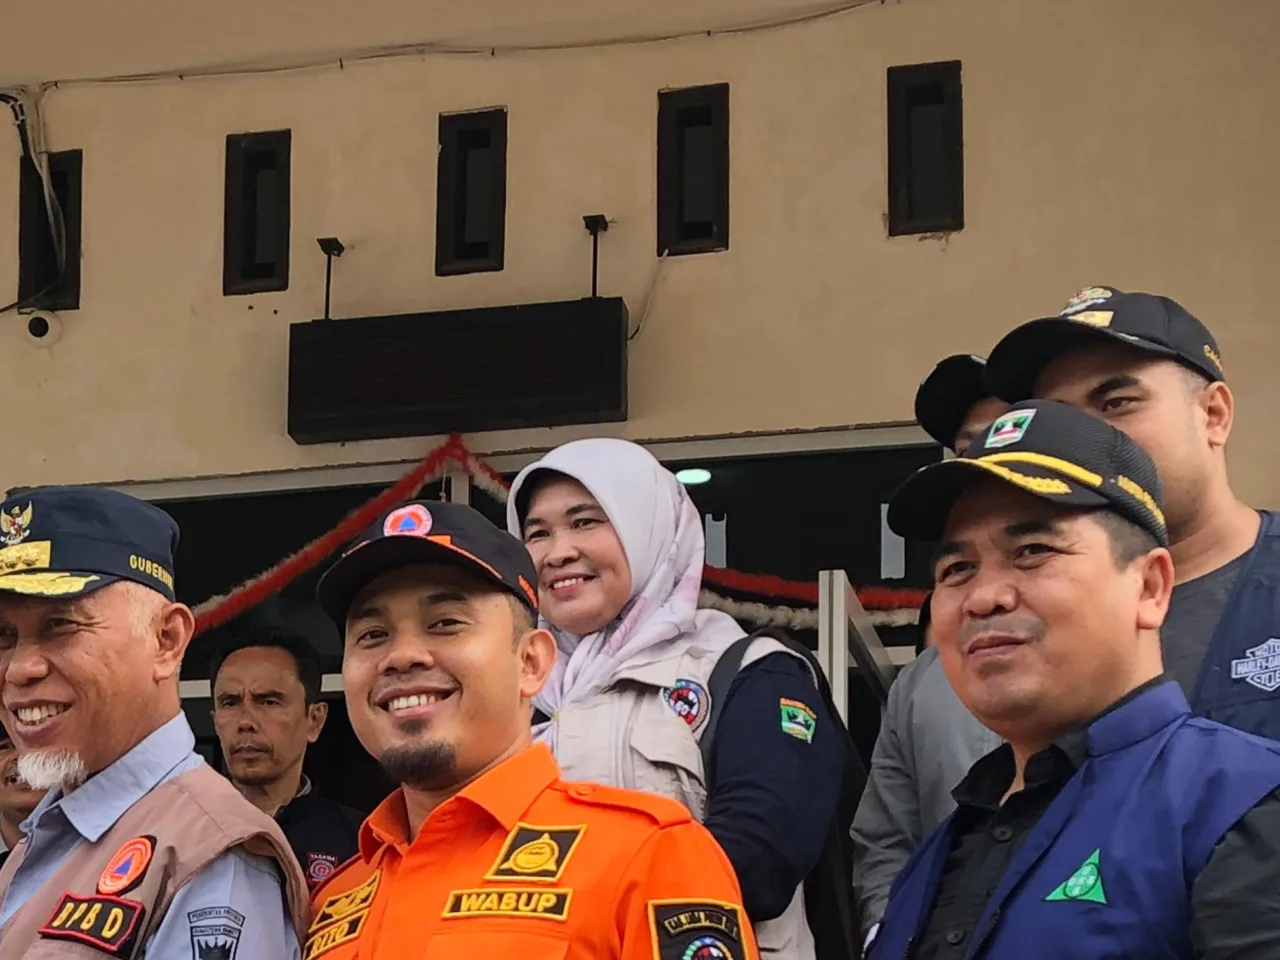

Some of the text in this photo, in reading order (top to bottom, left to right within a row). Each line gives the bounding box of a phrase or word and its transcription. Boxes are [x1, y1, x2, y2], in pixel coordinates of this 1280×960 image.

[130, 554, 173, 591] GUBER
[1236, 656, 1280, 675] HARLEY-DA
[460, 892, 557, 913] WABUP
